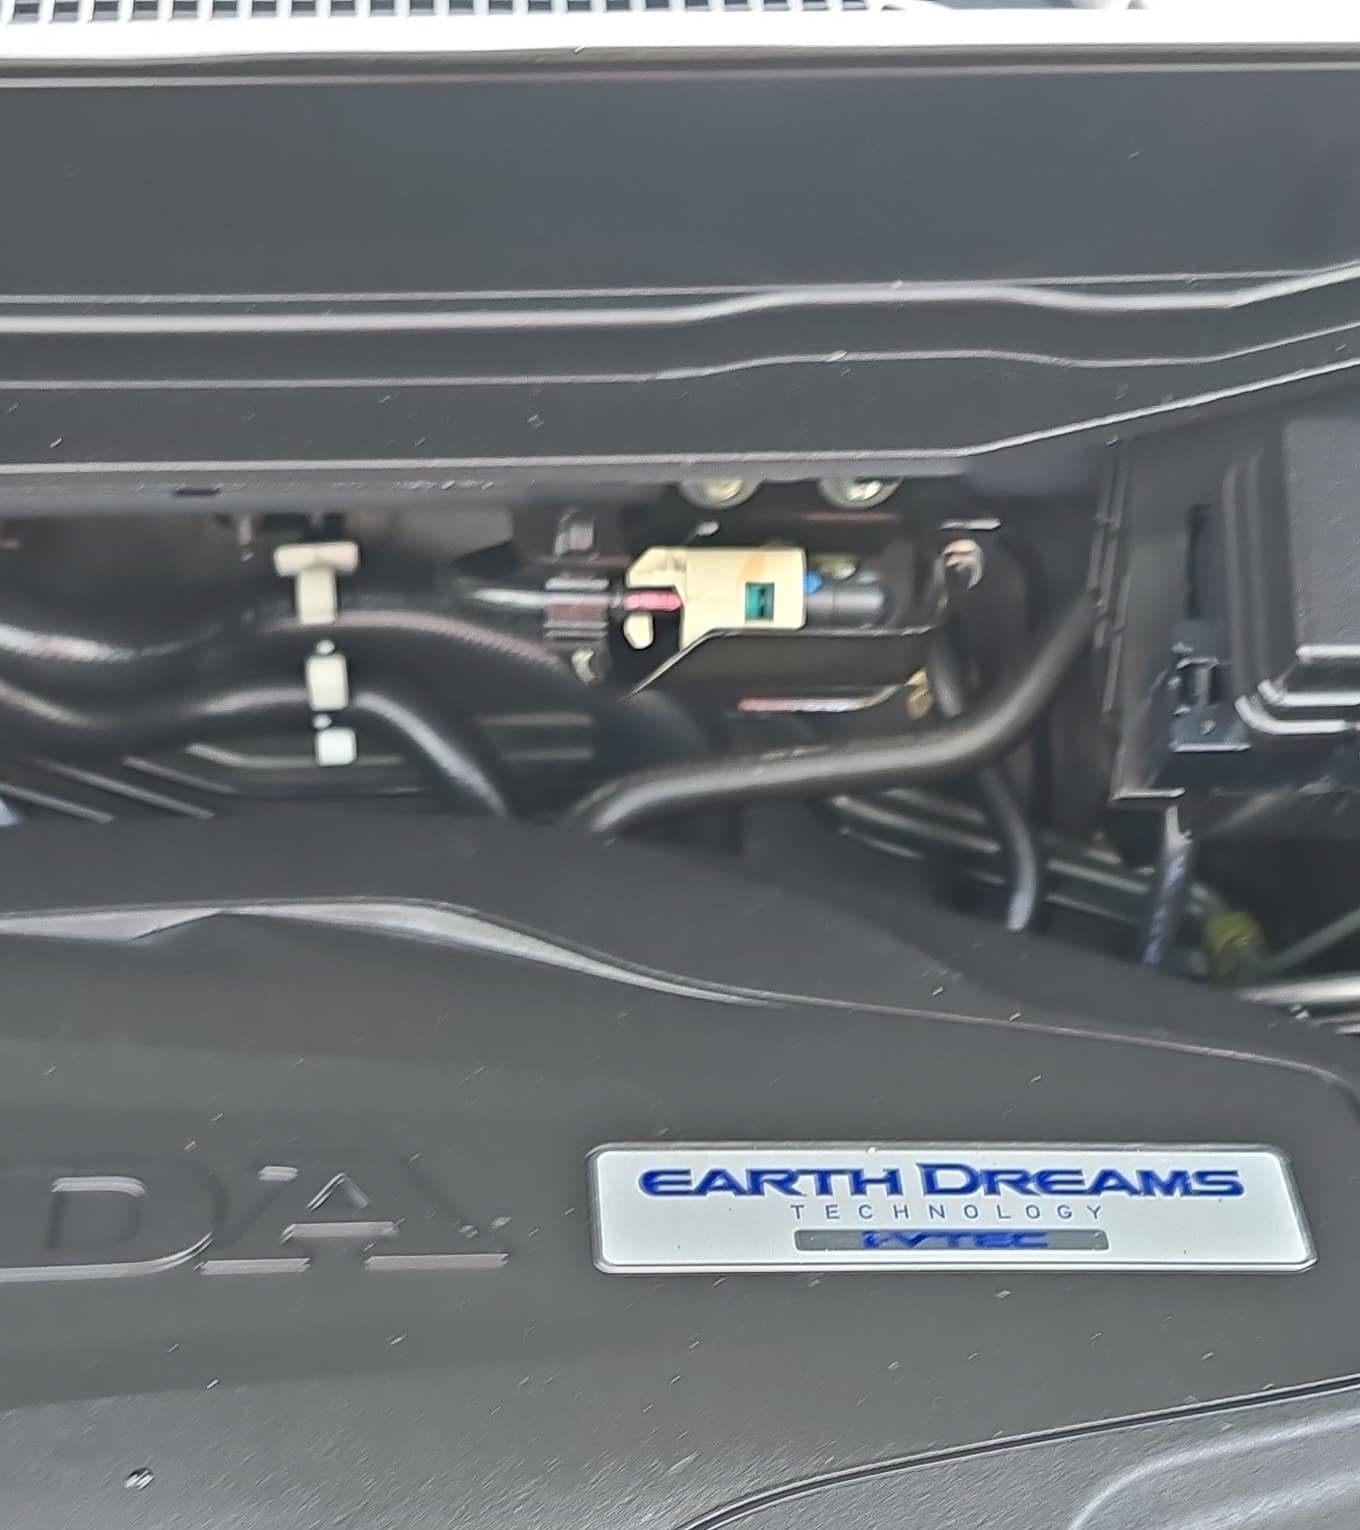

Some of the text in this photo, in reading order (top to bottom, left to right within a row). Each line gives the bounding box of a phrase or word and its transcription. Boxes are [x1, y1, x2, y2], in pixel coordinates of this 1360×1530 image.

[639, 1162, 1246, 1197] EARTH DREAMS
[789, 1203, 1103, 1220] TECHNOLOGY
